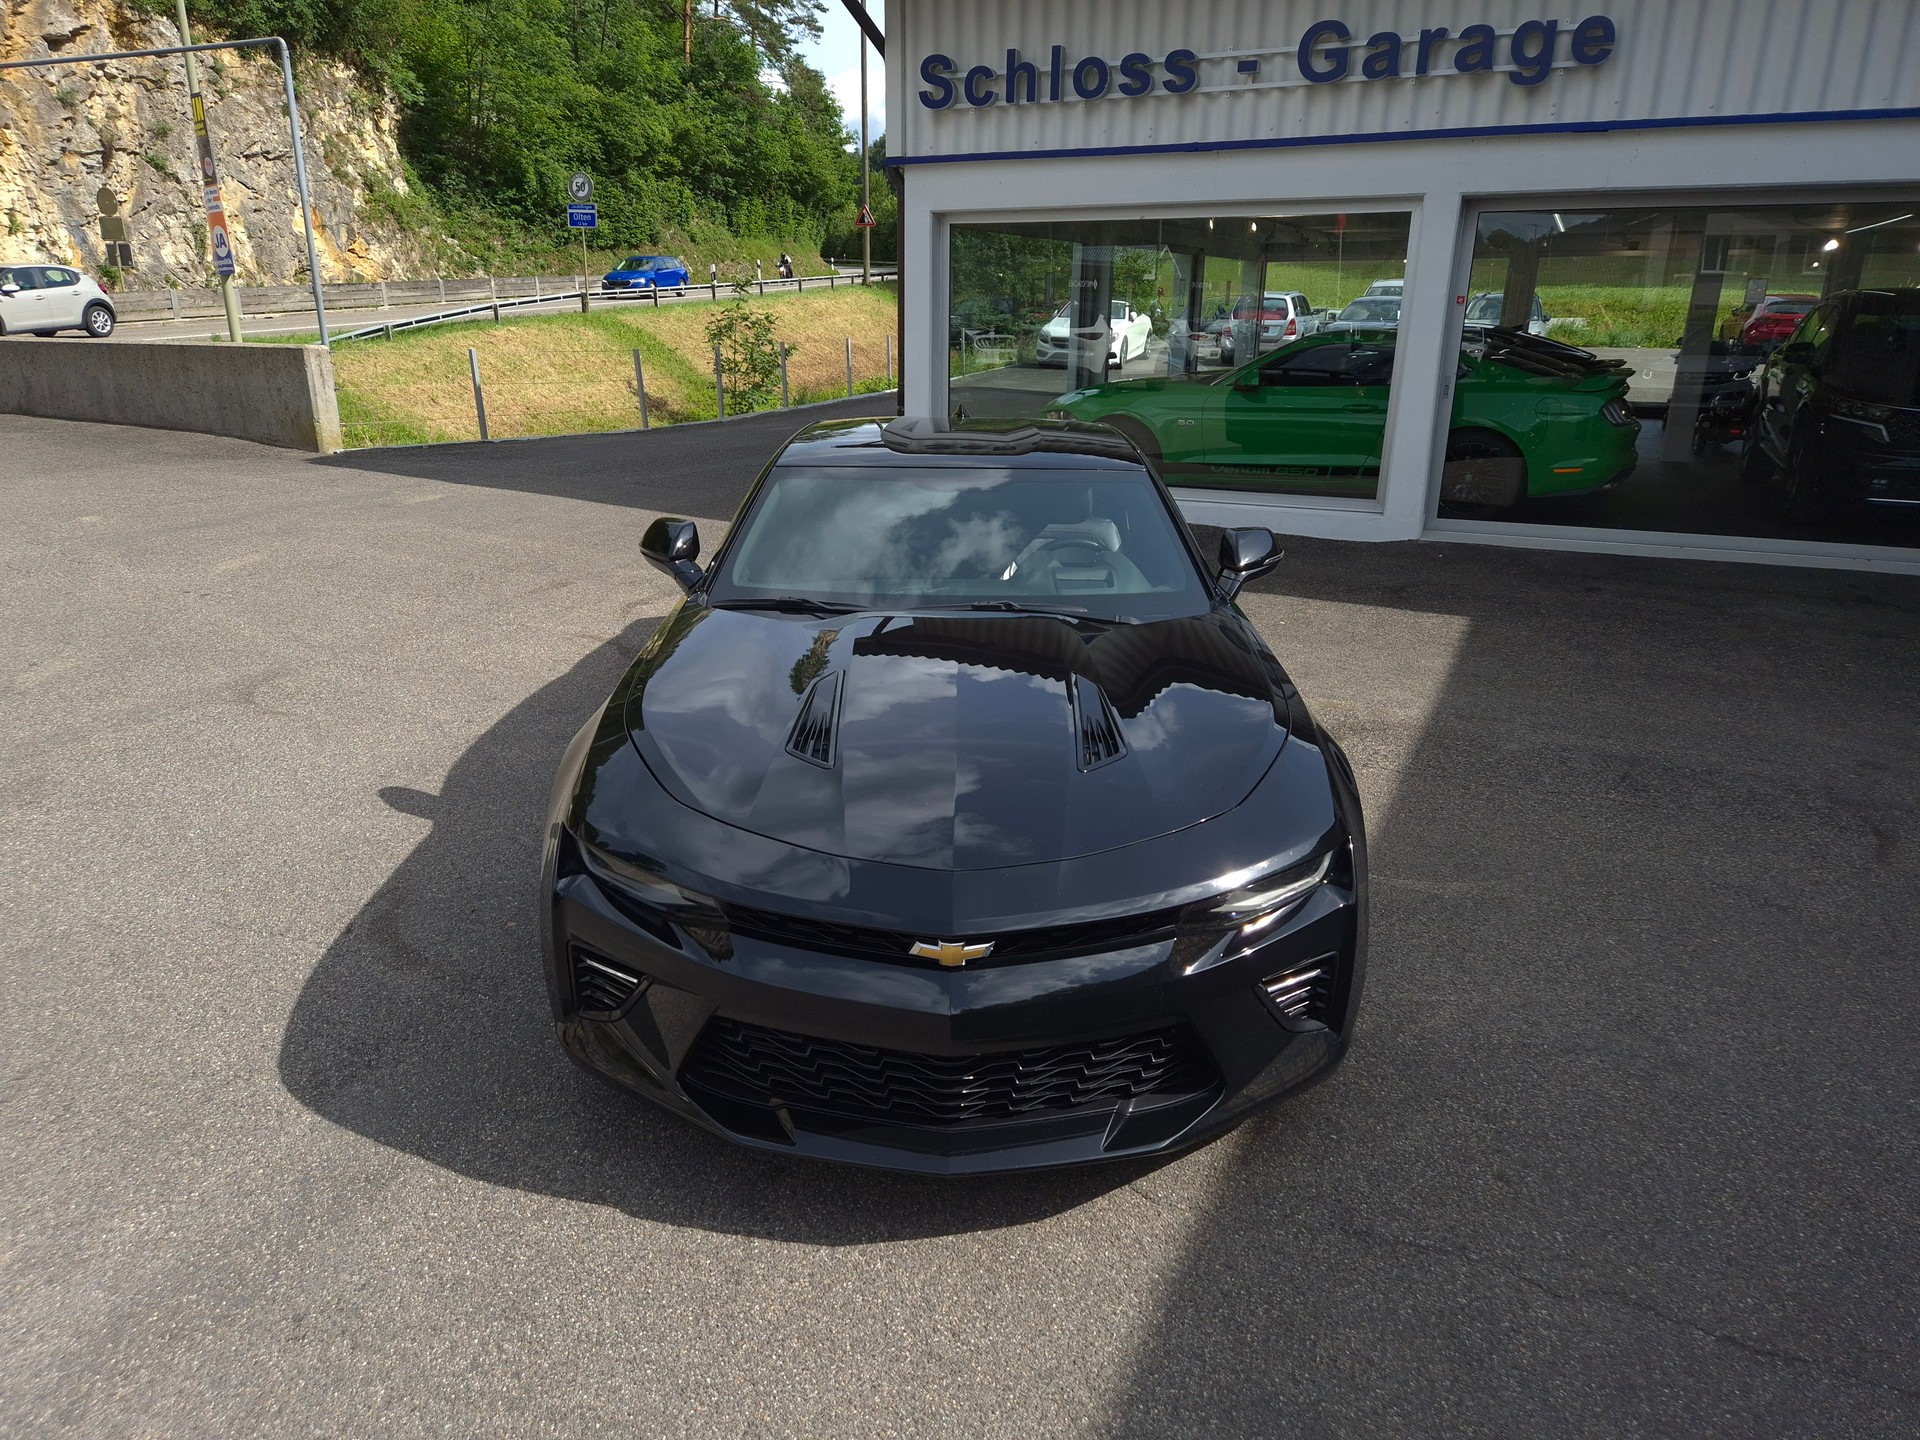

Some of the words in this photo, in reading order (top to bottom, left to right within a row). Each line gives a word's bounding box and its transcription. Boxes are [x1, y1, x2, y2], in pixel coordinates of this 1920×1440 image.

[918, 45, 1200, 110] Schloss
[1297, 15, 1617, 87] Garage
[575, 182, 585, 192] 50
[573, 213, 591, 221] Olten
[215, 233, 228, 248] JA
[1210, 465, 1271, 475] Venom
[1275, 467, 1319, 476] 850
